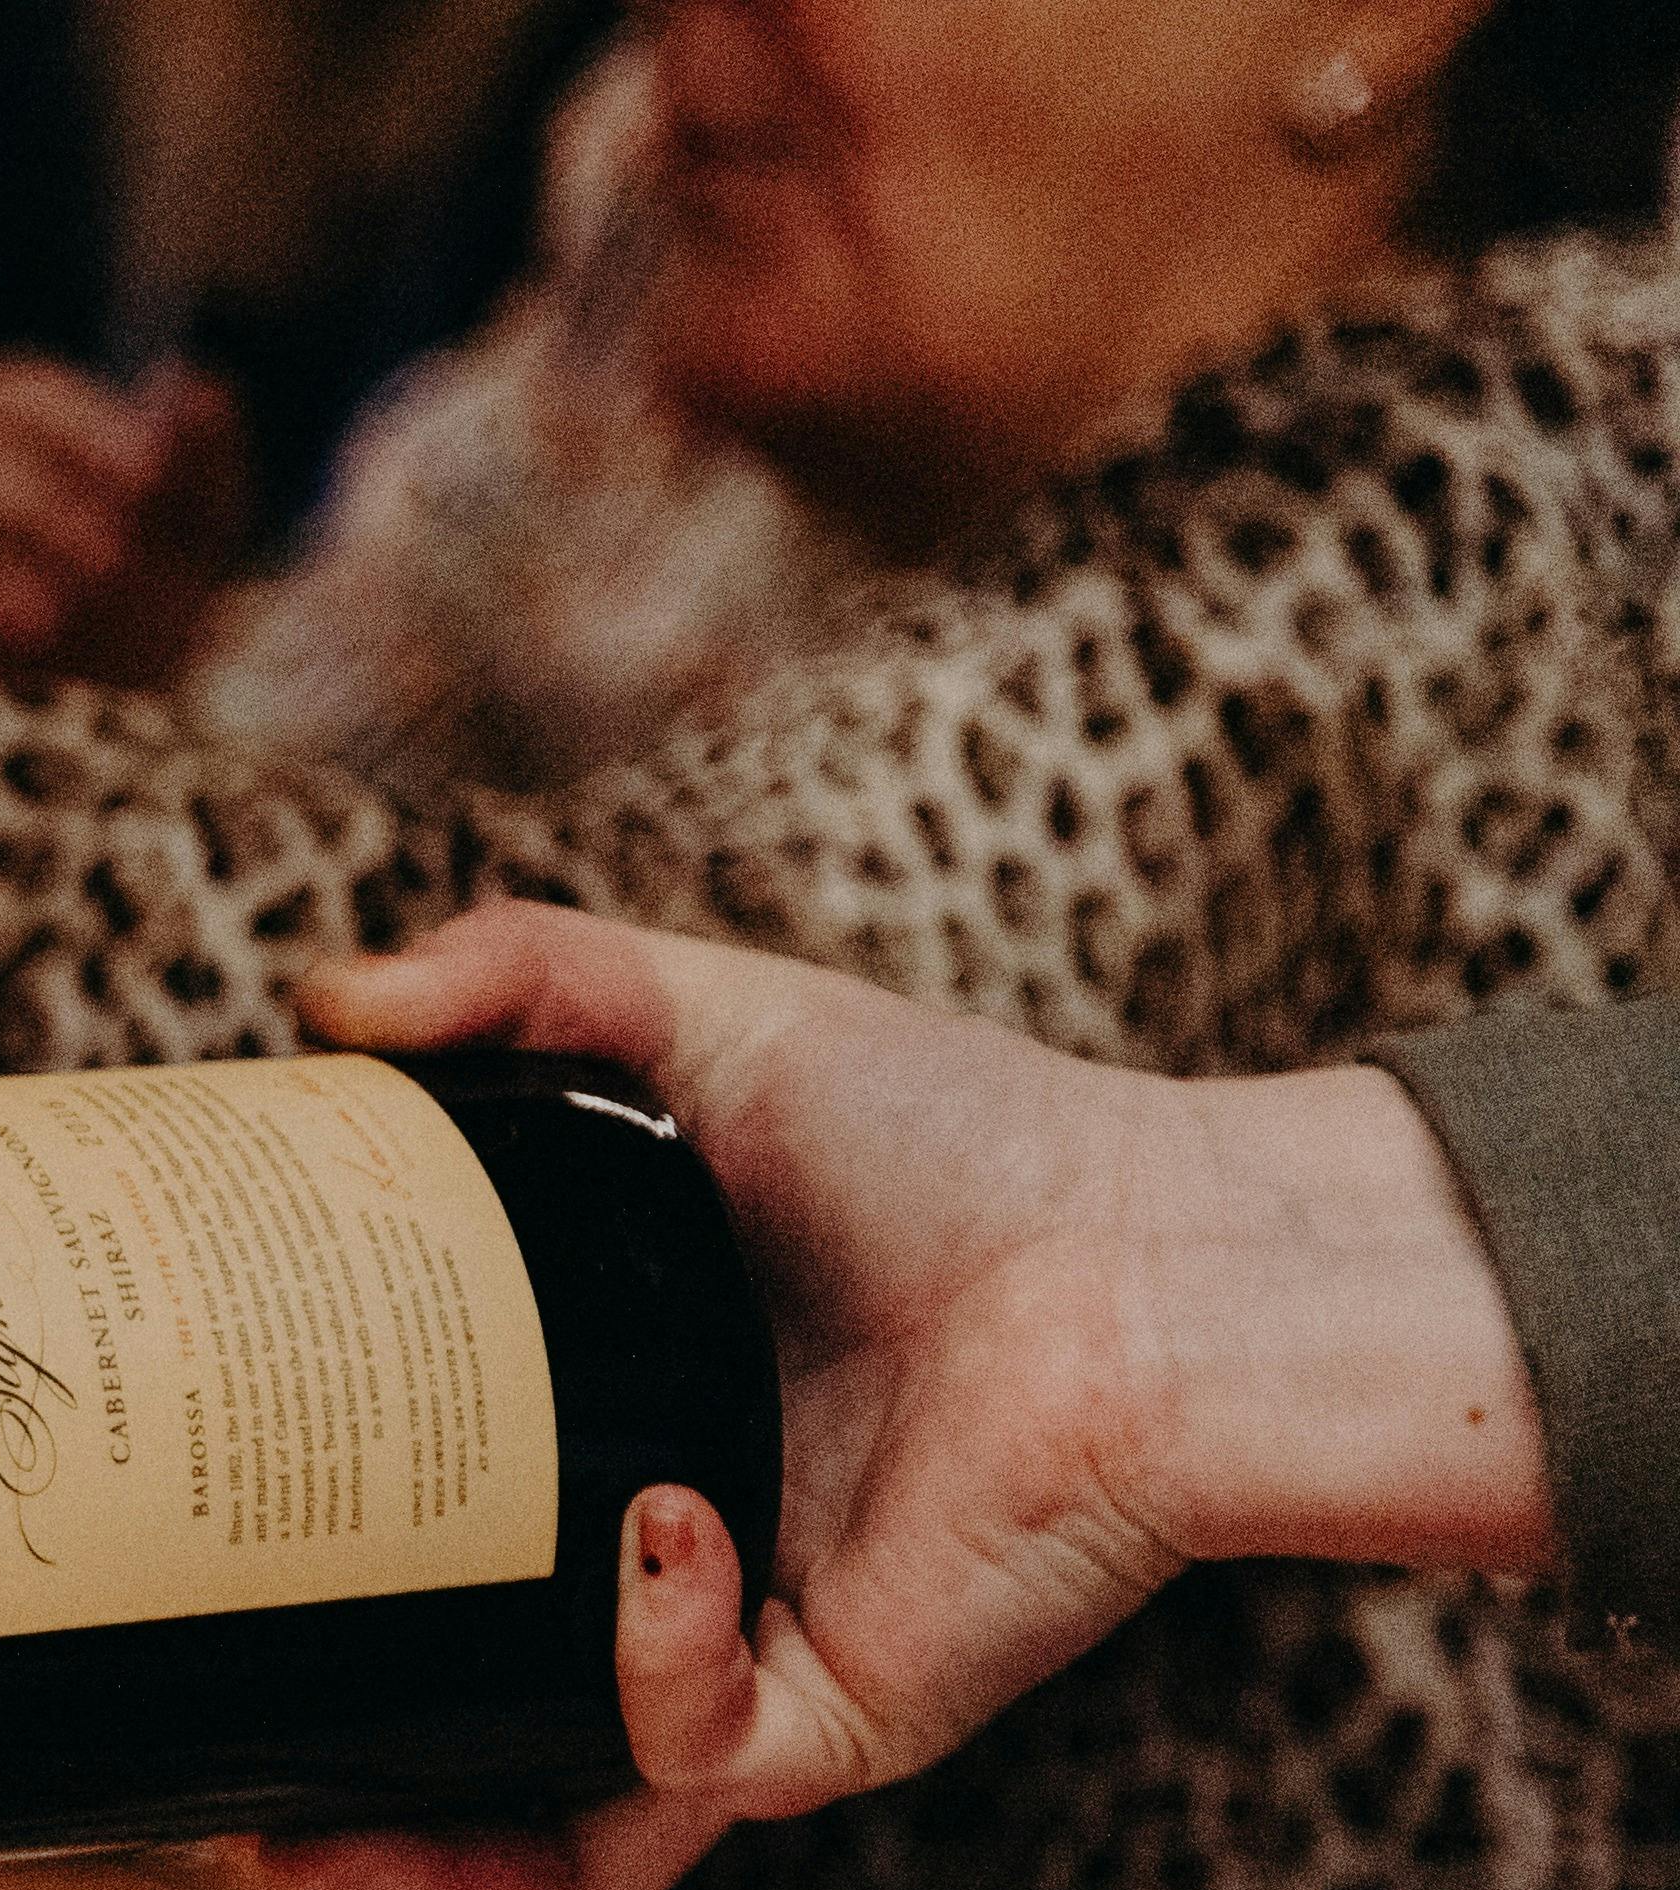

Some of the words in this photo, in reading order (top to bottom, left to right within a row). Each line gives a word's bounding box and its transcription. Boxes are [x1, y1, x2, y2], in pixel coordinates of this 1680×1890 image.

[109, 1168, 164, 1247] VINTAGE
[86, 1208, 146, 1322] SHIRAZ
[78, 1282, 130, 1465] CABERNET
[172, 1314, 197, 1361] THE
[266, 1360, 288, 1440] Cabernet
[182, 1387, 209, 1518] BAROSSA
[229, 1500, 243, 1545] Since
